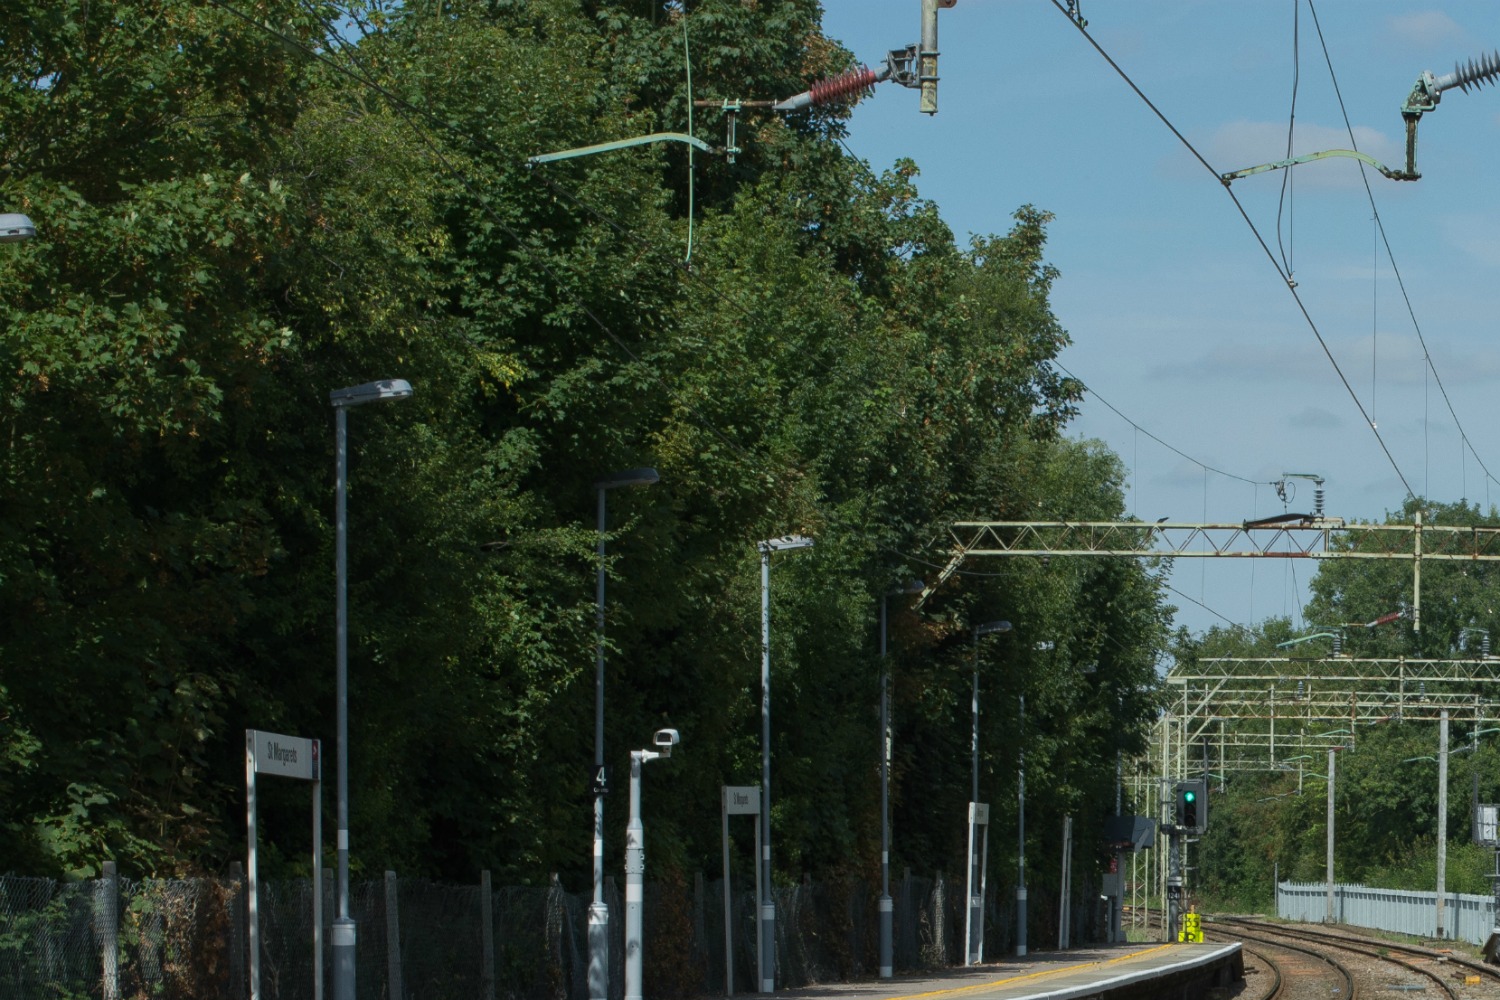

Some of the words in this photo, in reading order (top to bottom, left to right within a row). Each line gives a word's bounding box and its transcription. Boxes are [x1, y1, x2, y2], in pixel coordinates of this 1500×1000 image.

[267, 741, 273, 760] St
[273, 742, 297, 766] Margarets
[596, 766, 607, 786] 4
